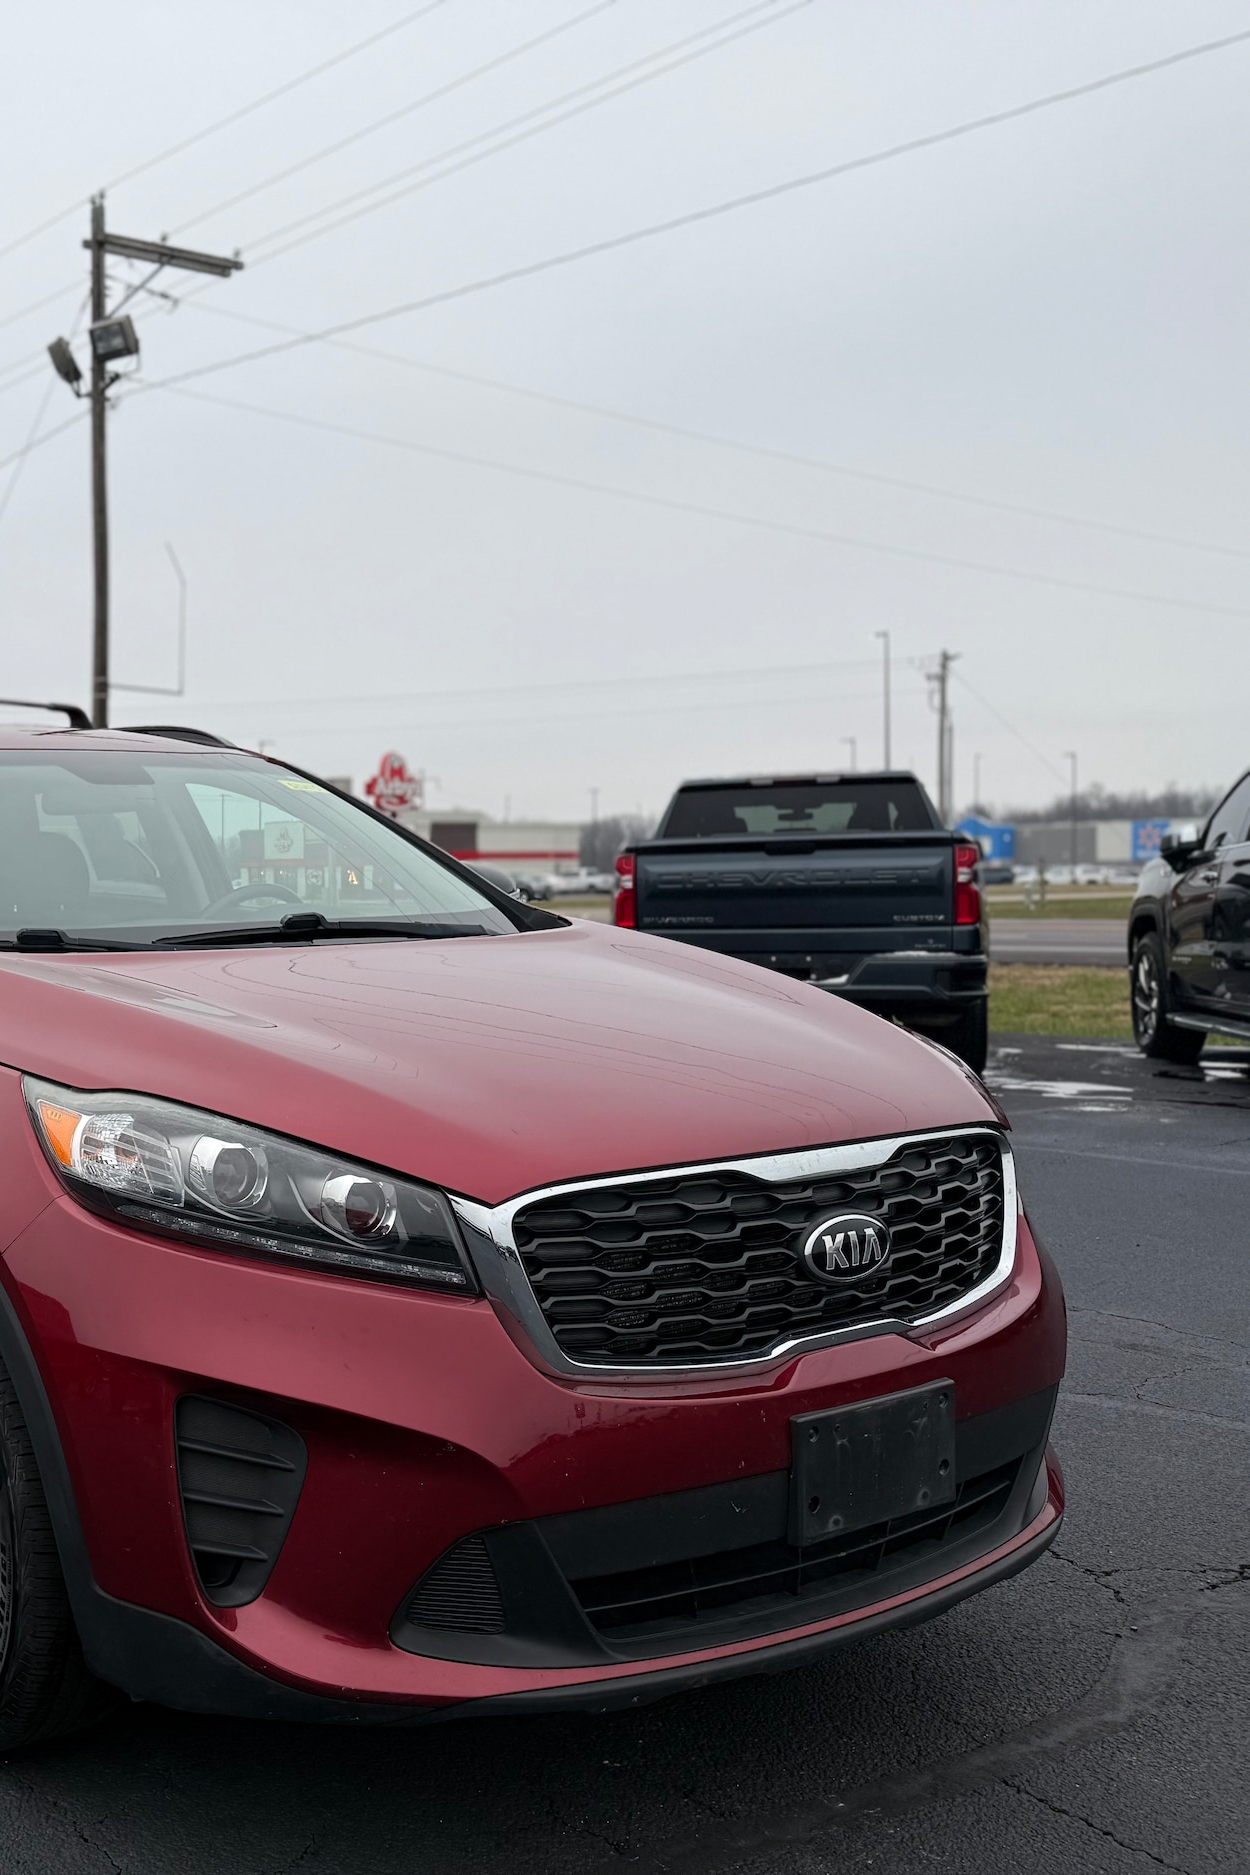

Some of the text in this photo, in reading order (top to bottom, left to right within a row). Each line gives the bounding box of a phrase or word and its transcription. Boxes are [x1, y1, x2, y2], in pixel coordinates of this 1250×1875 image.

[657, 869, 930, 889] CHEVROLET
[893, 914, 945, 922] CUSTOM
[822, 1227, 882, 1271] KIA
